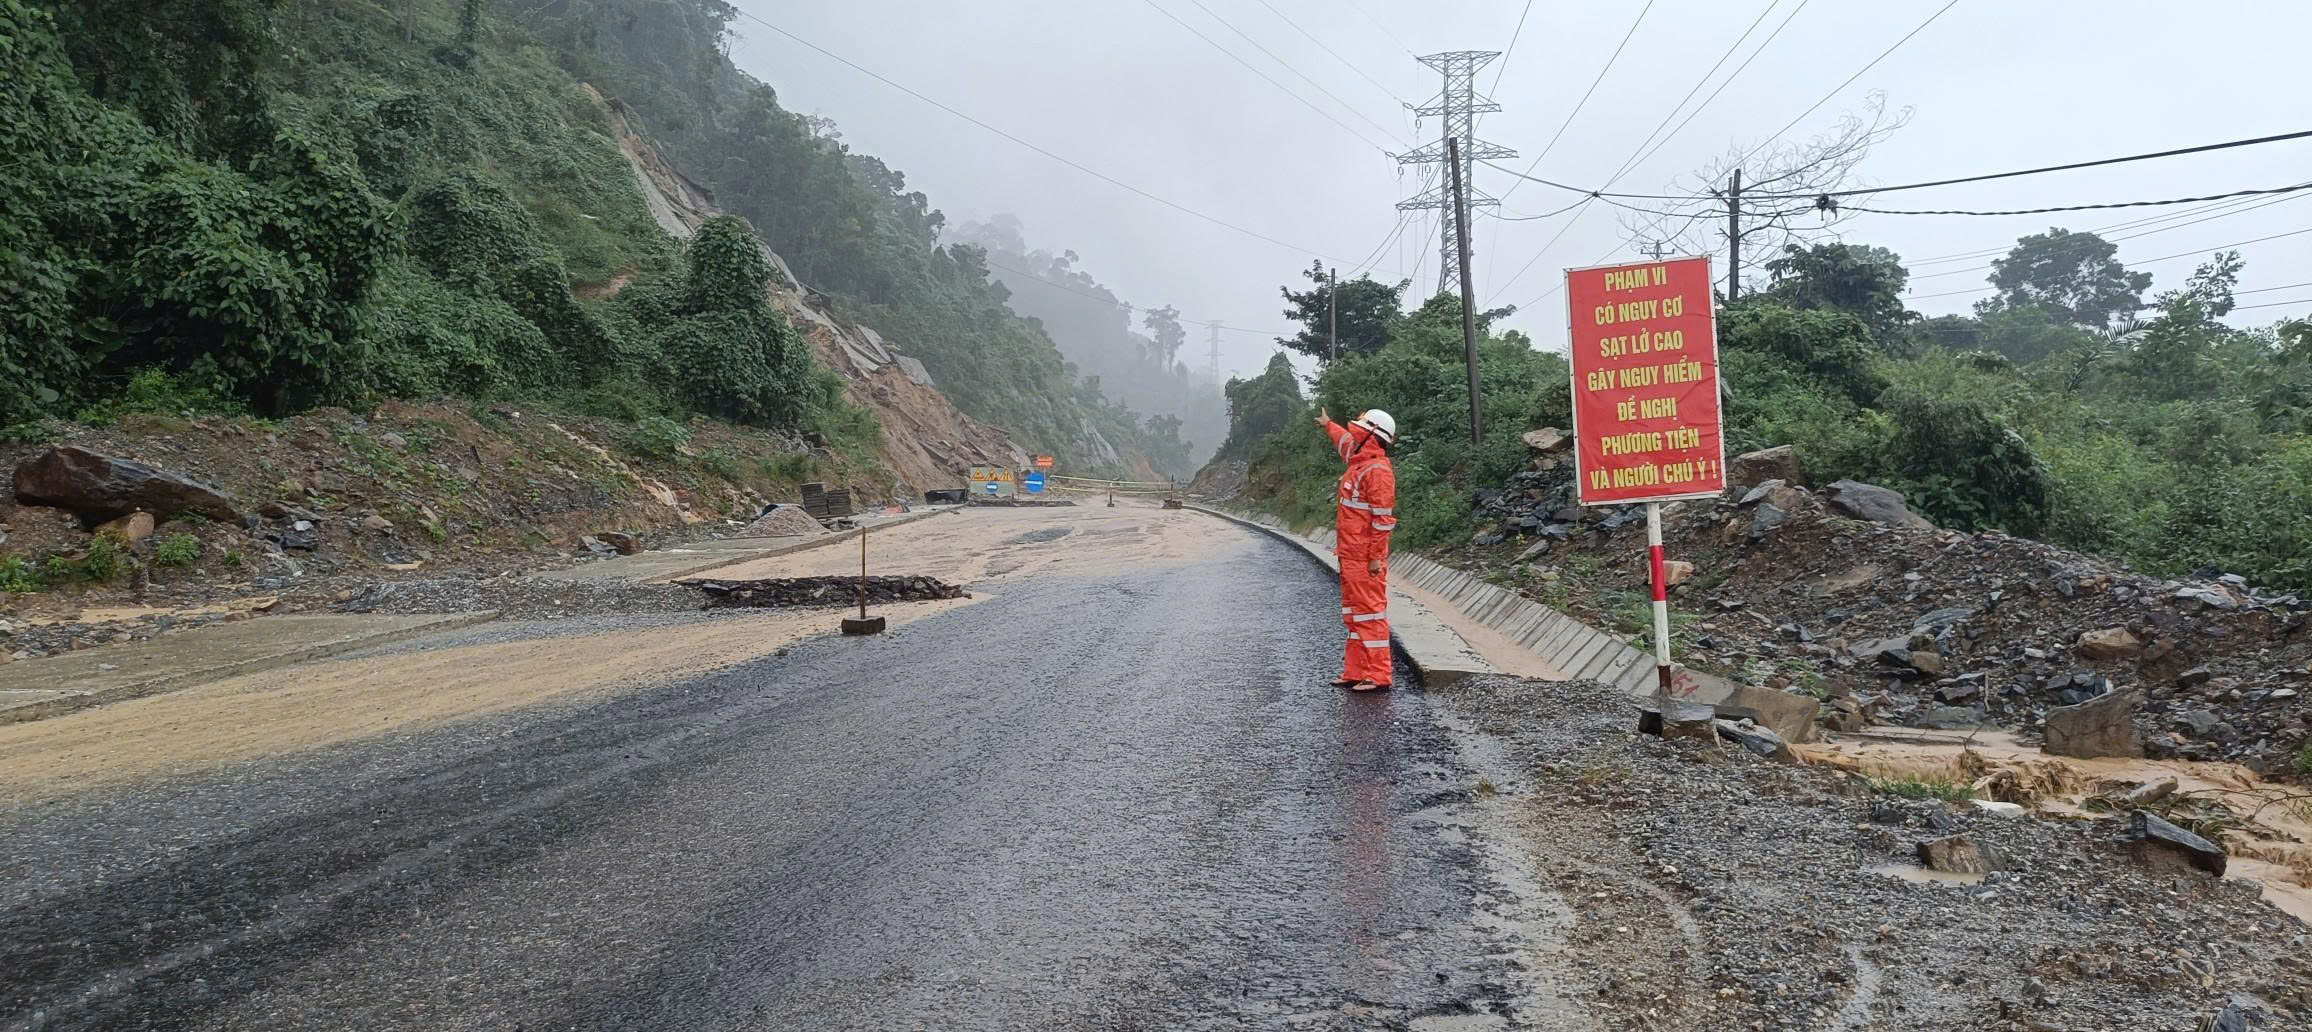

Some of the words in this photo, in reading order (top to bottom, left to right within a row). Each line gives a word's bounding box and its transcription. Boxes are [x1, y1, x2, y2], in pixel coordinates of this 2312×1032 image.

[1605, 269, 1648, 292] PHẠM
[1652, 266, 1666, 285] VI
[1596, 301, 1614, 325] CÓ
[1619, 300, 1657, 322] NGUY
[1663, 295, 1682, 317] CƠ
[1600, 336, 1627, 360] SẠT
[1632, 328, 1649, 353] LỞ
[1654, 331, 1683, 351] CAO
[1588, 367, 1615, 391] GÂY
[1620, 366, 1658, 387] NGUY
[1664, 355, 1702, 383] HIỂM
[1641, 398, 1676, 420] NGHỊ
[1602, 433, 1662, 455] PHƯƠNG
[1665, 426, 1699, 452] TIỆN
[1590, 467, 1610, 489] VÀ
[1614, 462, 1659, 487] NGƯỜI
[1663, 459, 1693, 483] CHÚ
[1697, 457, 1705, 480] Ý
